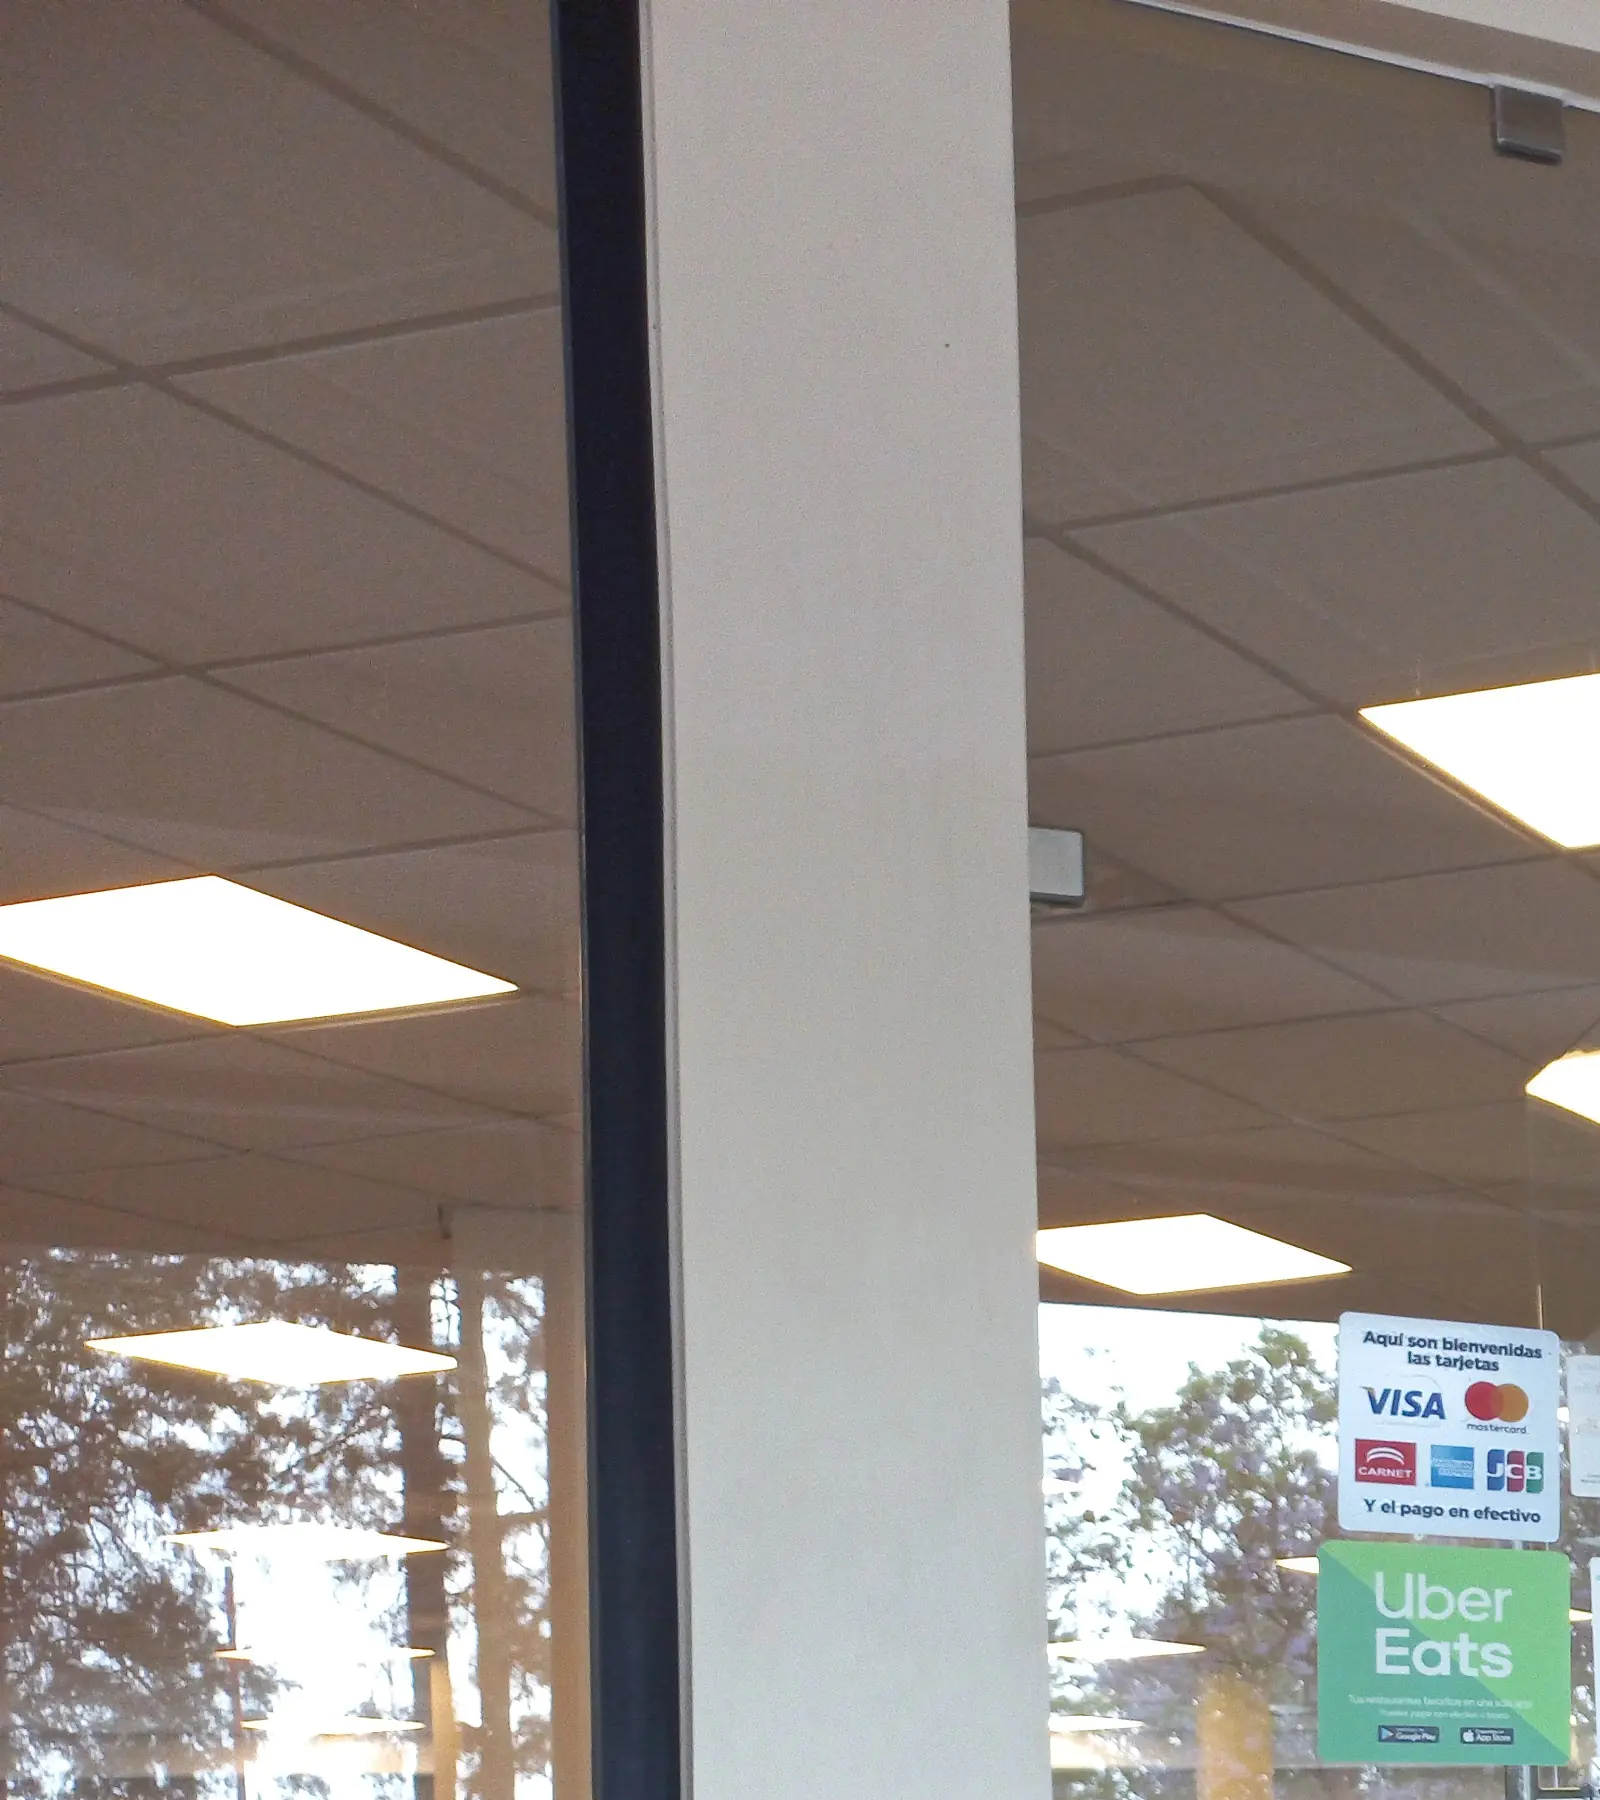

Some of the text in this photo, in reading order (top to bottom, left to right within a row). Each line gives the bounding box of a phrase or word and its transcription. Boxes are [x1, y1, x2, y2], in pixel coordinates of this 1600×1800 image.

[1408, 1335, 1438, 1350] son
[1442, 1337, 1543, 1359] bienvenidas
[1407, 1351, 1500, 1372] las tarjetas
[1360, 1385, 1447, 1420] VISA
[1467, 1423, 1528, 1434] mastercard
[1358, 1466, 1413, 1478] CARNET
[1487, 1463, 1542, 1480] JCB
[1364, 1498, 1541, 1523] Y el pago en efectivo
[1375, 1571, 1513, 1623] Uber
[1375, 1627, 1514, 1678] Eats
